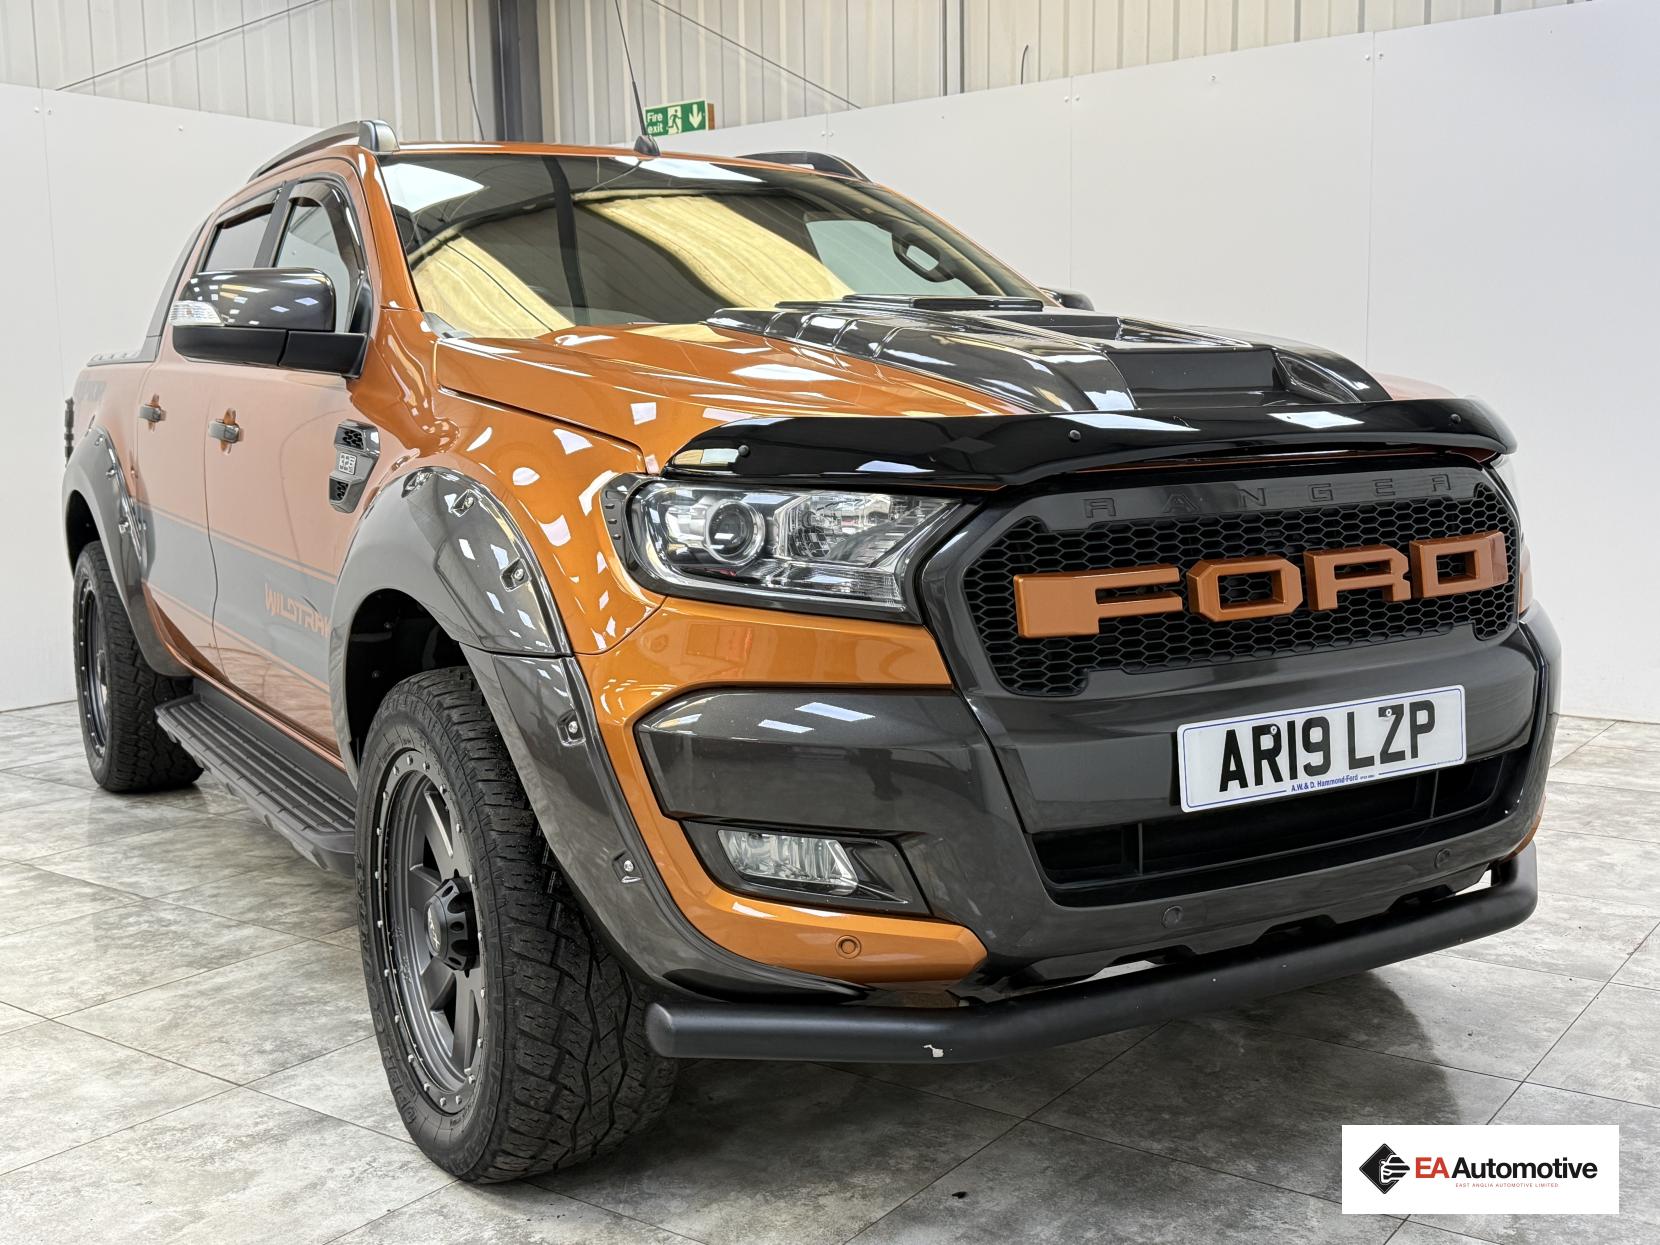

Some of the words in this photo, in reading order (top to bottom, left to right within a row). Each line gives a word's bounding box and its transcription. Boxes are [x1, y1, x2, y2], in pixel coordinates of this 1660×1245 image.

[647, 112, 663, 122] Fire
[647, 123, 663, 133] exit
[1084, 474, 1452, 519] RANGER
[1013, 531, 1509, 639] FORD
[1219, 716, 1332, 792] AR19
[1347, 700, 1436, 770] LZP
